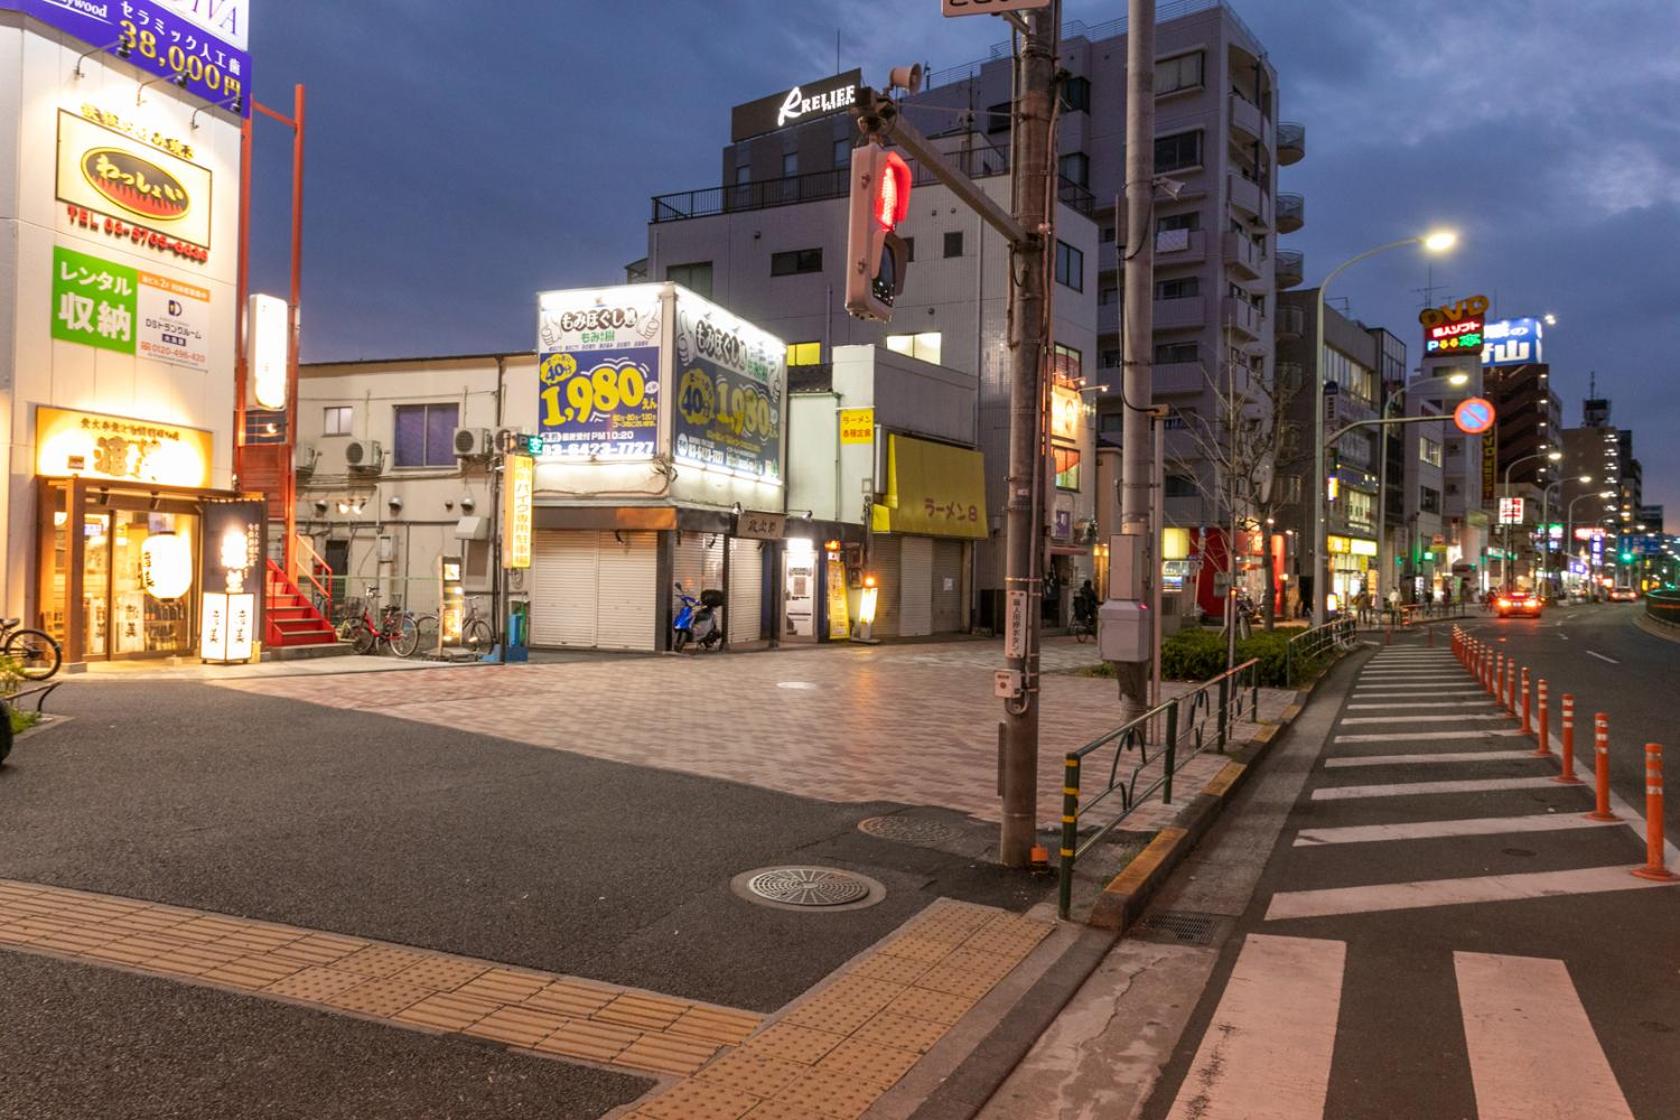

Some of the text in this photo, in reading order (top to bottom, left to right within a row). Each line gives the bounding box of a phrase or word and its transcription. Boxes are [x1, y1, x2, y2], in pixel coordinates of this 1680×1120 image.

[60, 261, 132, 297] レンタル
[58, 291, 132, 342] 収納
[541, 366, 645, 426] 1,980
